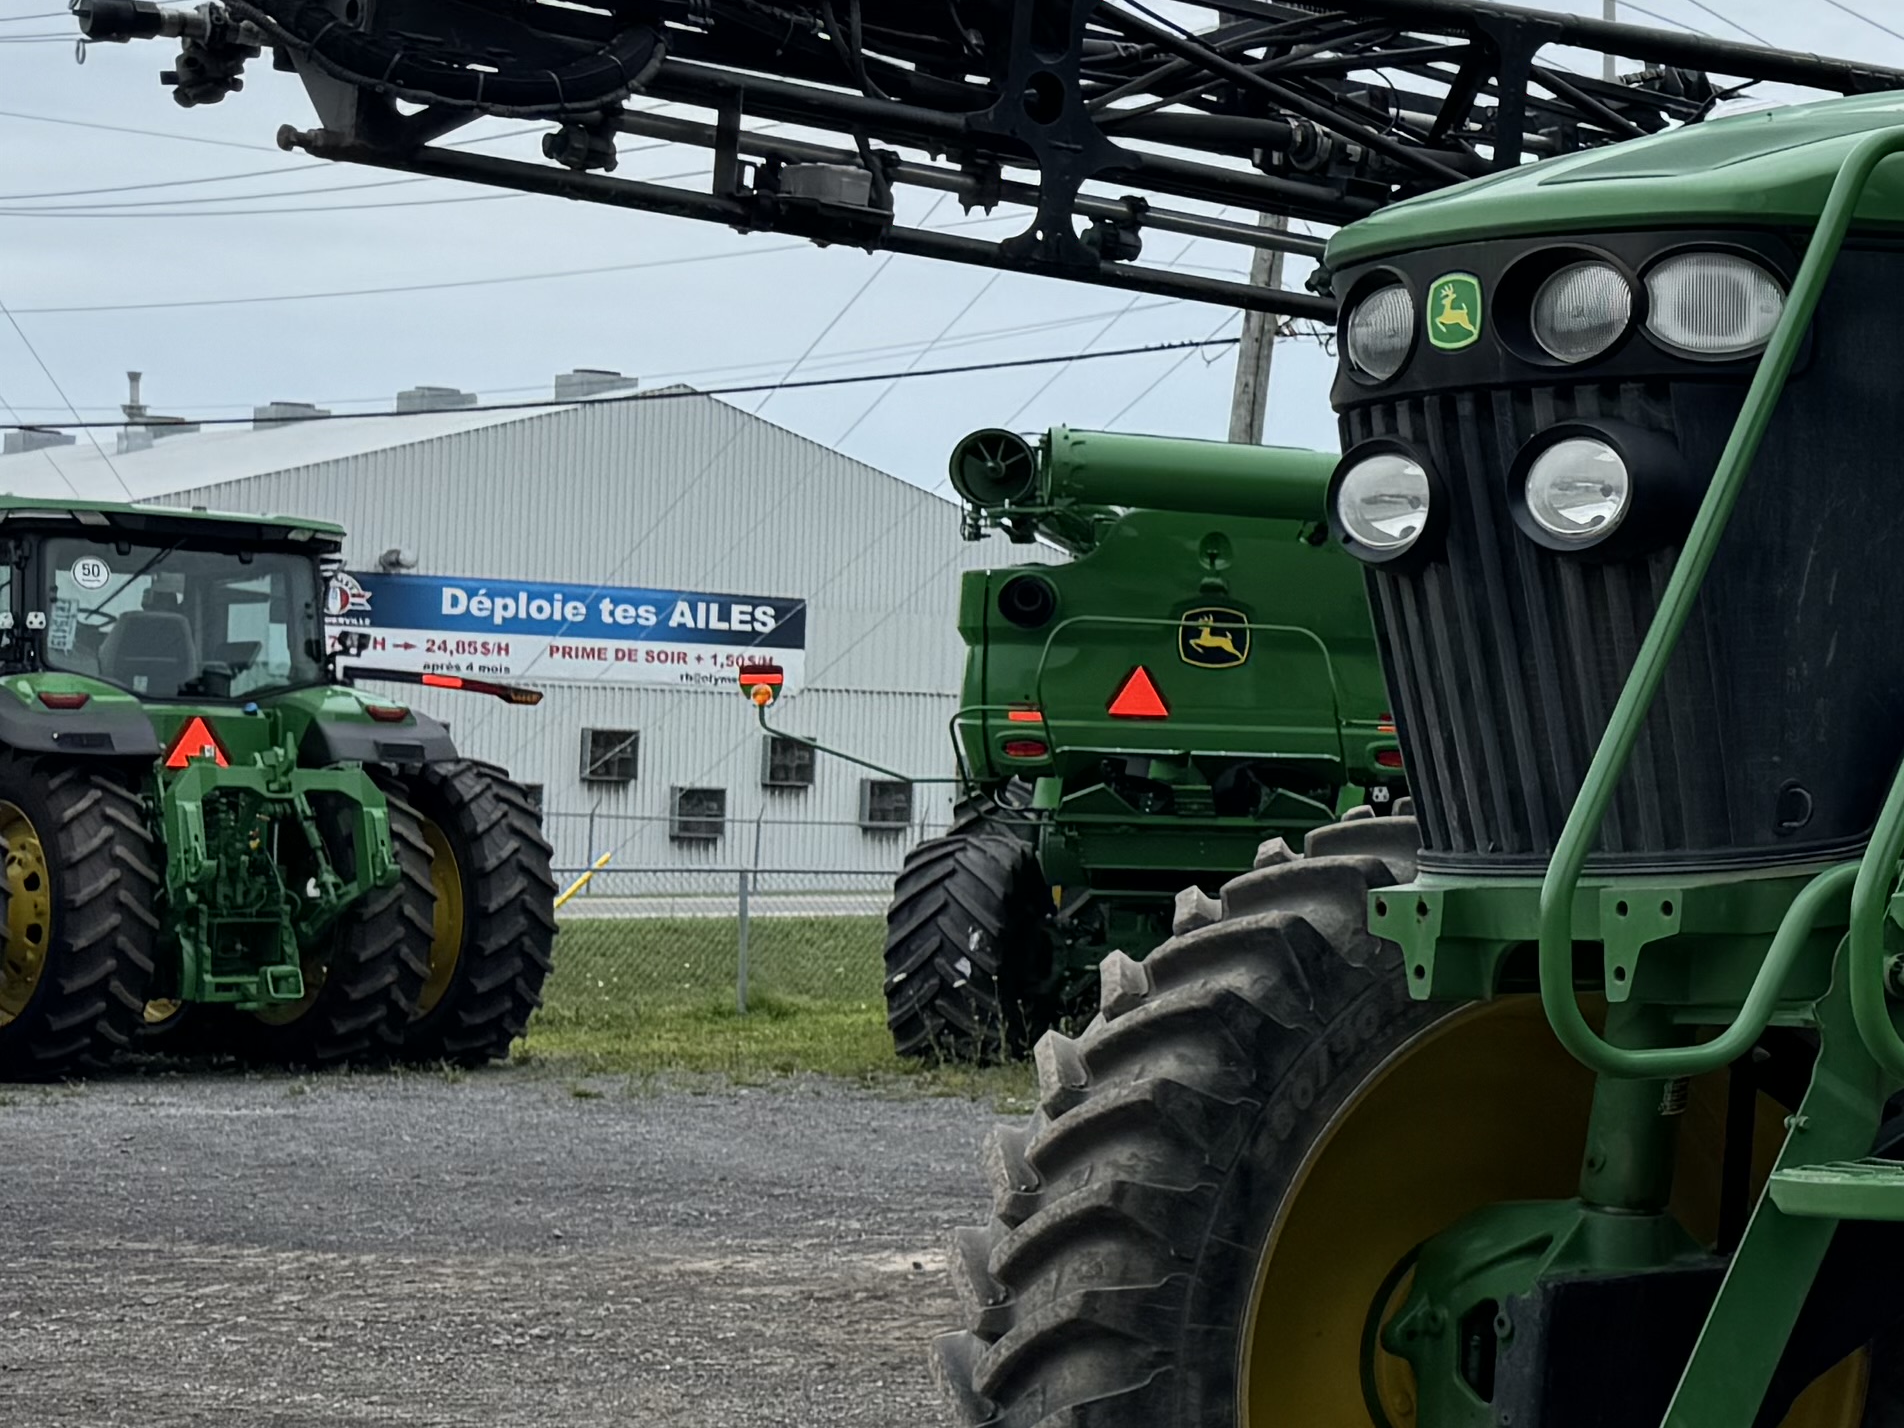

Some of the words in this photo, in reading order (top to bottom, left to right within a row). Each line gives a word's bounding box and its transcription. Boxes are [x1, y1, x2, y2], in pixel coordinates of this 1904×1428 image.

[81, 563, 101, 578] 50
[442, 586, 588, 625] Déploie
[599, 596, 657, 626] tes
[668, 600, 777, 634] AILES
[548, 645, 608, 662] PRIME
[614, 647, 639, 663] DE
[644, 649, 689, 666] SOIR
[422, 661, 462, 678] après
[466, 663, 474, 673] 4
[478, 663, 512, 675] mois
